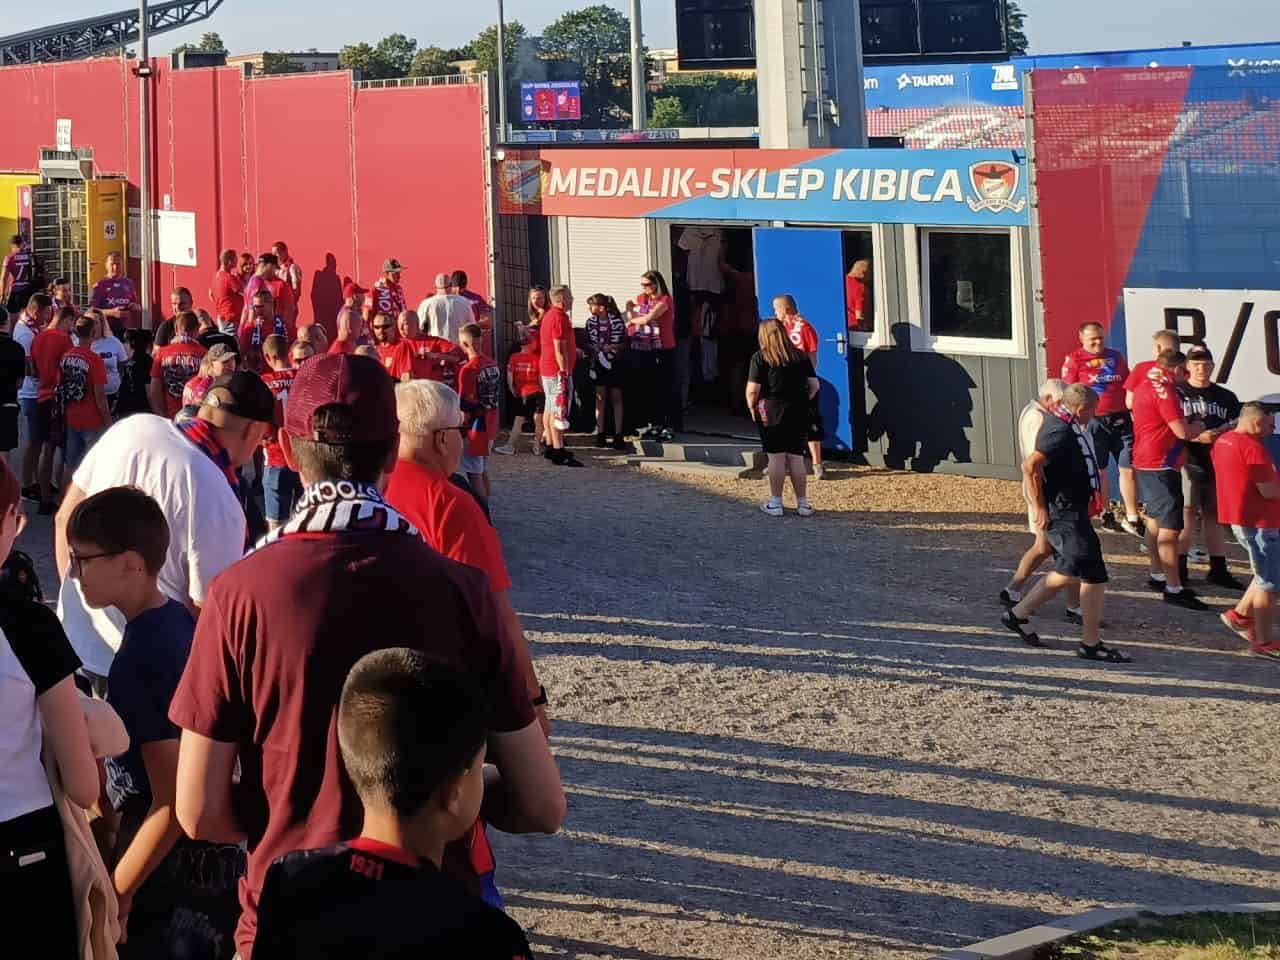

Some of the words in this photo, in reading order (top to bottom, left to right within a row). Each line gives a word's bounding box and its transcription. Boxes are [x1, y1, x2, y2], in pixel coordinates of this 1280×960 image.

[911, 74, 954, 87] TAURON
[549, 167, 825, 201] MEDALIK-SKLEP
[832, 168, 963, 203] KIBICA
